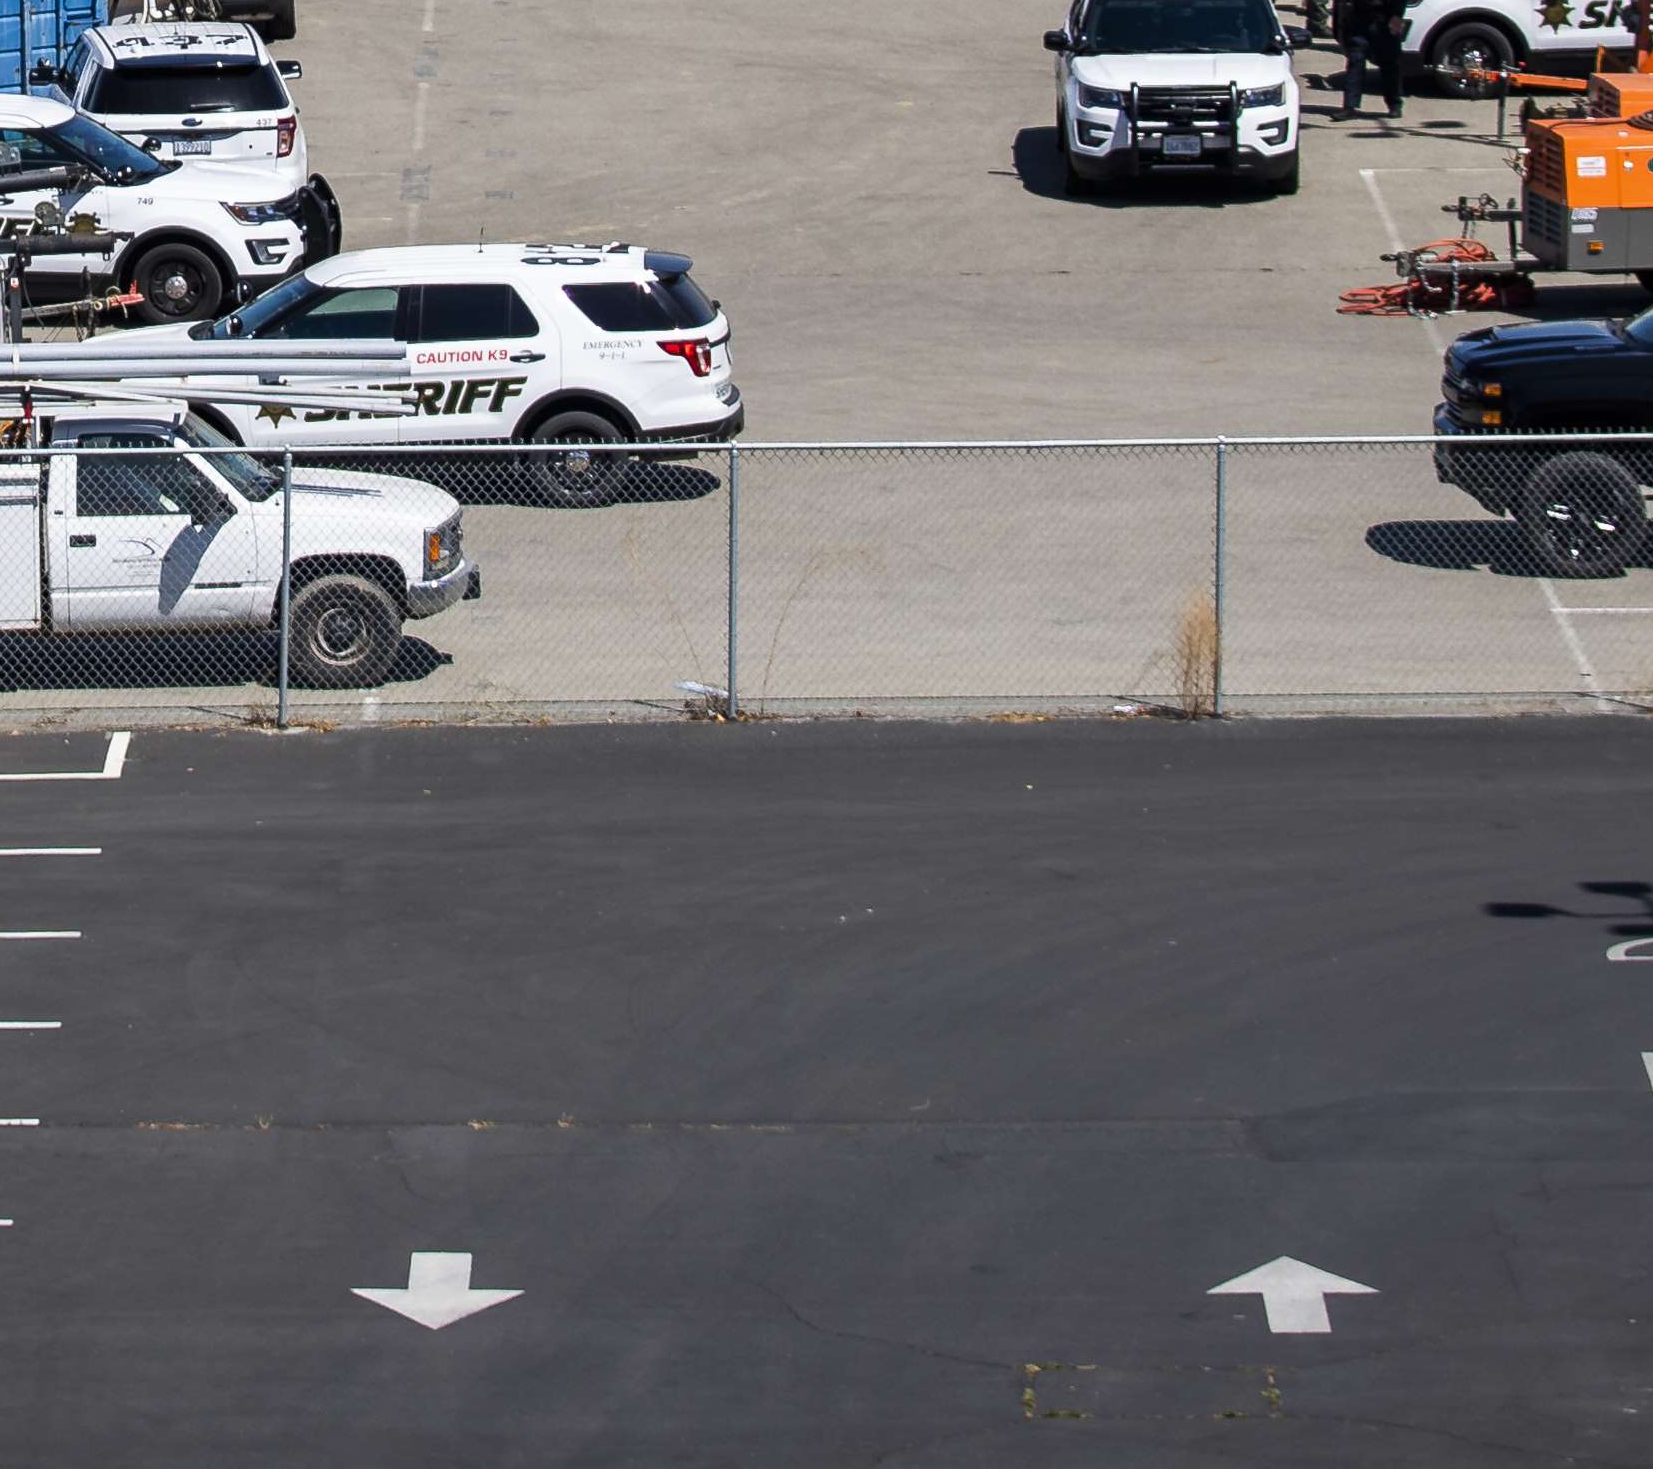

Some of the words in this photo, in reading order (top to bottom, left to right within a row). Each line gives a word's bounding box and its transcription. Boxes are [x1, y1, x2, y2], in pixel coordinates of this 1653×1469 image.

[137, 197, 154, 206] 749
[582, 340, 644, 350] EMERGENCY
[416, 351, 483, 364] CAUTION
[487, 349, 509, 361] K9
[598, 351, 626, 360] 9-1-1
